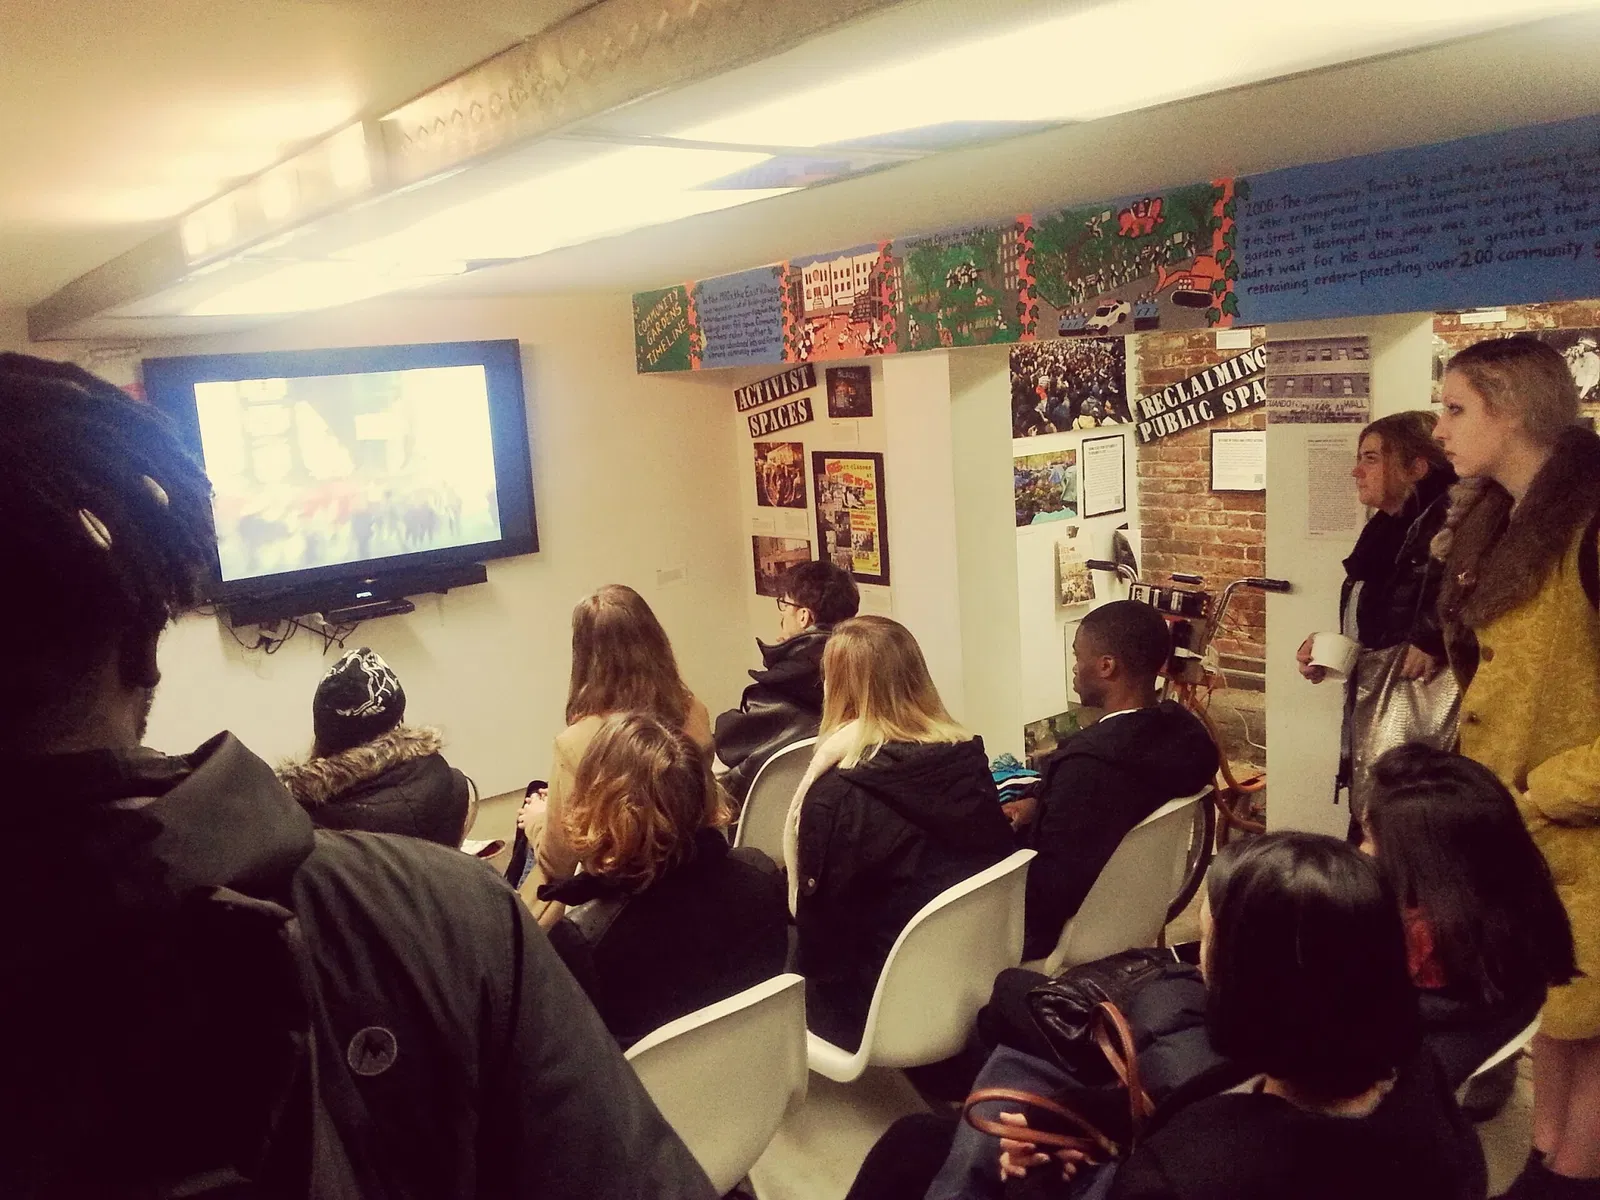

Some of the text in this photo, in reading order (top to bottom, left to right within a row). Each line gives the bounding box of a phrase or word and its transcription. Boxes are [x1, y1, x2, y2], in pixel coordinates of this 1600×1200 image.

[1281, 194, 1300, 209] The
[1244, 248, 1281, 265] garden
[1287, 244, 1305, 256] got
[1375, 228, 1393, 239] the
[1477, 215, 1493, 226] so
[1503, 206, 1542, 226] upset
[1554, 200, 1590, 216] that
[1279, 261, 1306, 275] wait
[1314, 254, 1334, 269] for
[1340, 250, 1361, 264] his
[1457, 234, 1475, 246] he
[1484, 223, 1546, 248] granted
[1555, 225, 1564, 234] a
[1303, 224, 1325, 237] This
[1247, 279, 1309, 296] restraining
[1427, 257, 1458, 271] over
[1460, 249, 1494, 268] 200
[1499, 240, 1585, 262] community
[637, 288, 678, 336] COMMUNITY
[647, 302, 682, 345] GARDENS
[647, 318, 688, 365] TIMELINE
[740, 366, 809, 410] ACTIVIST
[1140, 345, 1266, 419] RECLAIMING
[751, 400, 807, 437] SPACES
[1139, 378, 1266, 442] PUBLIC SPA
